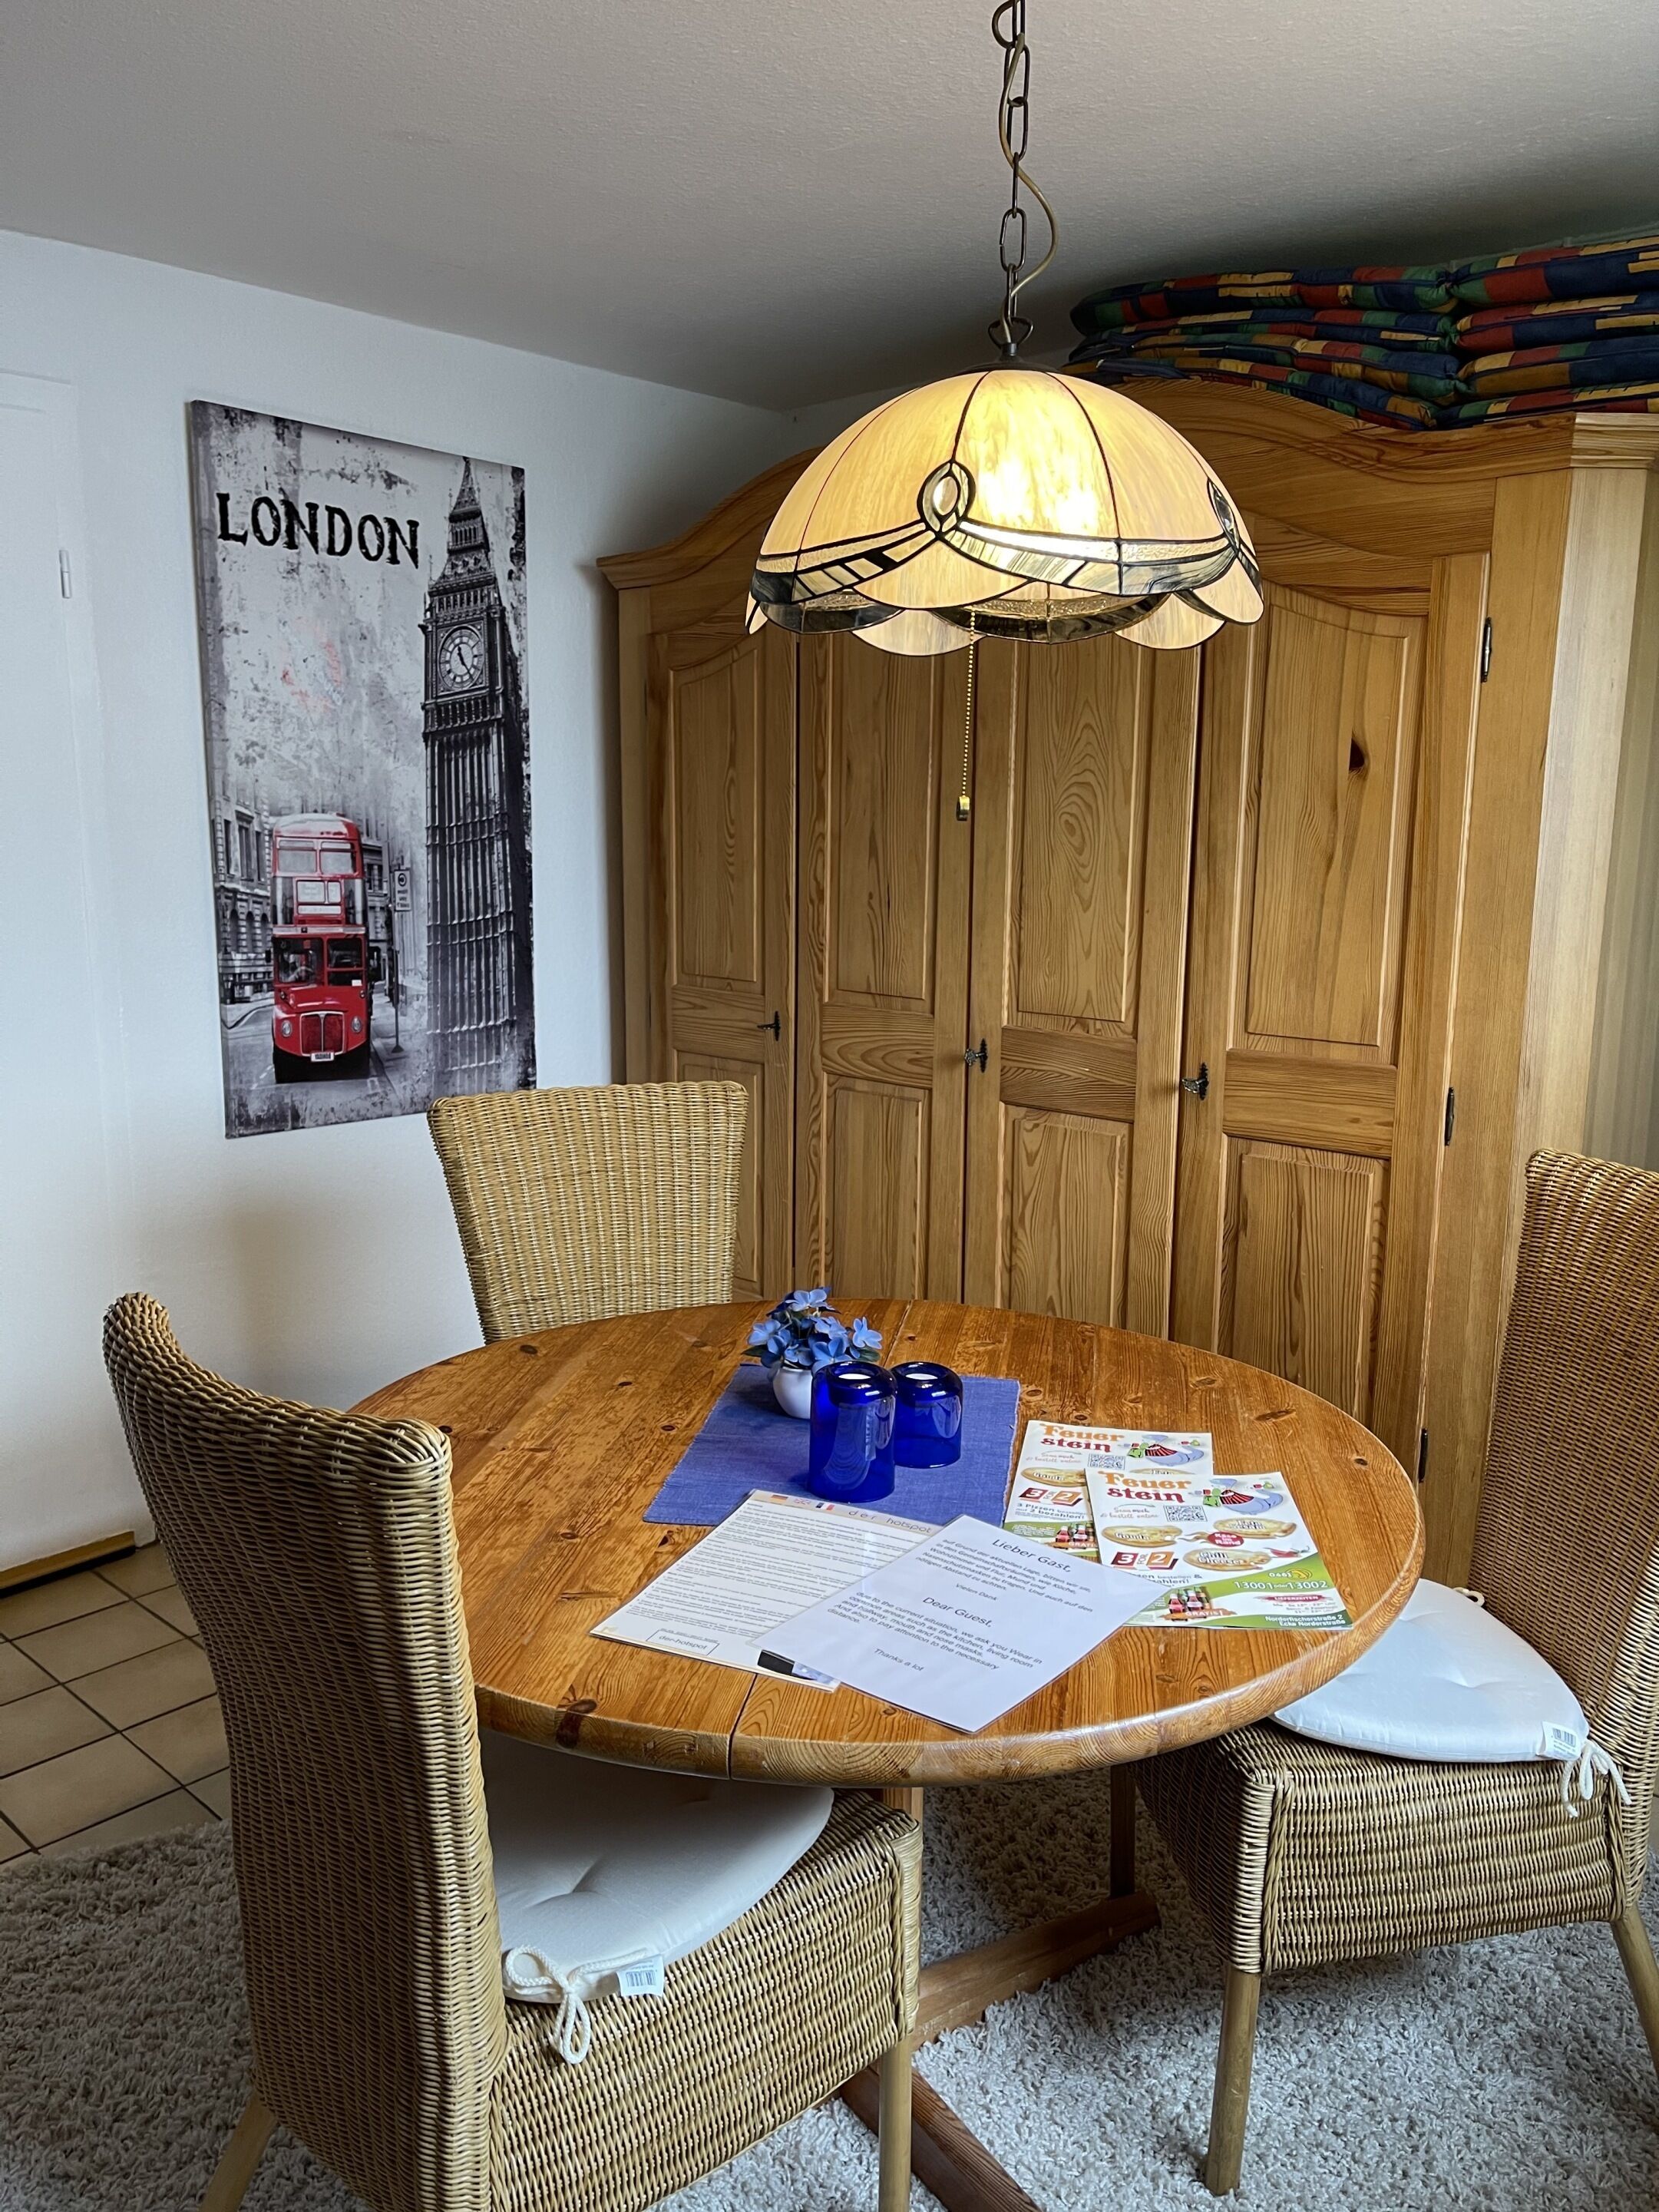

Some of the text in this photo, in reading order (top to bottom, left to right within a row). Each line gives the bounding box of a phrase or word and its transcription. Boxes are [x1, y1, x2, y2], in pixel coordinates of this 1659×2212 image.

[216, 493, 419, 569] LONDON
[1039, 1423, 1125, 1441] Feuer
[1041, 1437, 1112, 1453] stein
[1098, 1471, 1191, 1489] Feuer
[1026, 1489, 1043, 1497] 3
[1058, 1492, 1075, 1501] 2
[1107, 1488, 1185, 1503] stein
[1026, 1503, 1055, 1512] Pizzen
[848, 1510, 933, 1533] der hotspot
[955, 1542, 977, 1552] Grund
[990, 1556, 1023, 1569] aktuellen
[992, 1539, 1072, 1572] Lieber Gast,
[1117, 1554, 1135, 1563] 3
[1151, 1553, 1168, 1563] 2
[930, 1547, 976, 1566] Wohnzimmer
[1007, 1575, 1030, 1585] Mund
[941, 1566, 973, 1579] Abstand
[956, 1582, 997, 1601] Vielen Dank
[1028, 1588, 1045, 1596] Und
[1044, 1594, 1063, 1602] auch
[1234, 1582, 1273, 1590] 13001
[923, 1597, 993, 1628] Dear Guest,
[834, 1604, 852, 1612] And
[851, 1610, 869, 1619] also
[877, 1621, 894, 1629] pay
[894, 1627, 930, 1643] attention
[954, 1650, 1000, 1670] necessary
[849, 1596, 882, 1611] common
[882, 1609, 906, 1619] areas
[906, 1618, 926, 1627] such
[986, 1647, 1010, 1660] living
[1010, 1657, 1034, 1668] room
[890, 1618, 916, 1630] mouth
[934, 1635, 954, 1645] nose
[895, 1606, 924, 1618] current
[974, 1636, 990, 1645] ask
[990, 1642, 1009, 1652] you
[1009, 1648, 1034, 1661] Wear
[874, 1648, 904, 1664] Thanks
